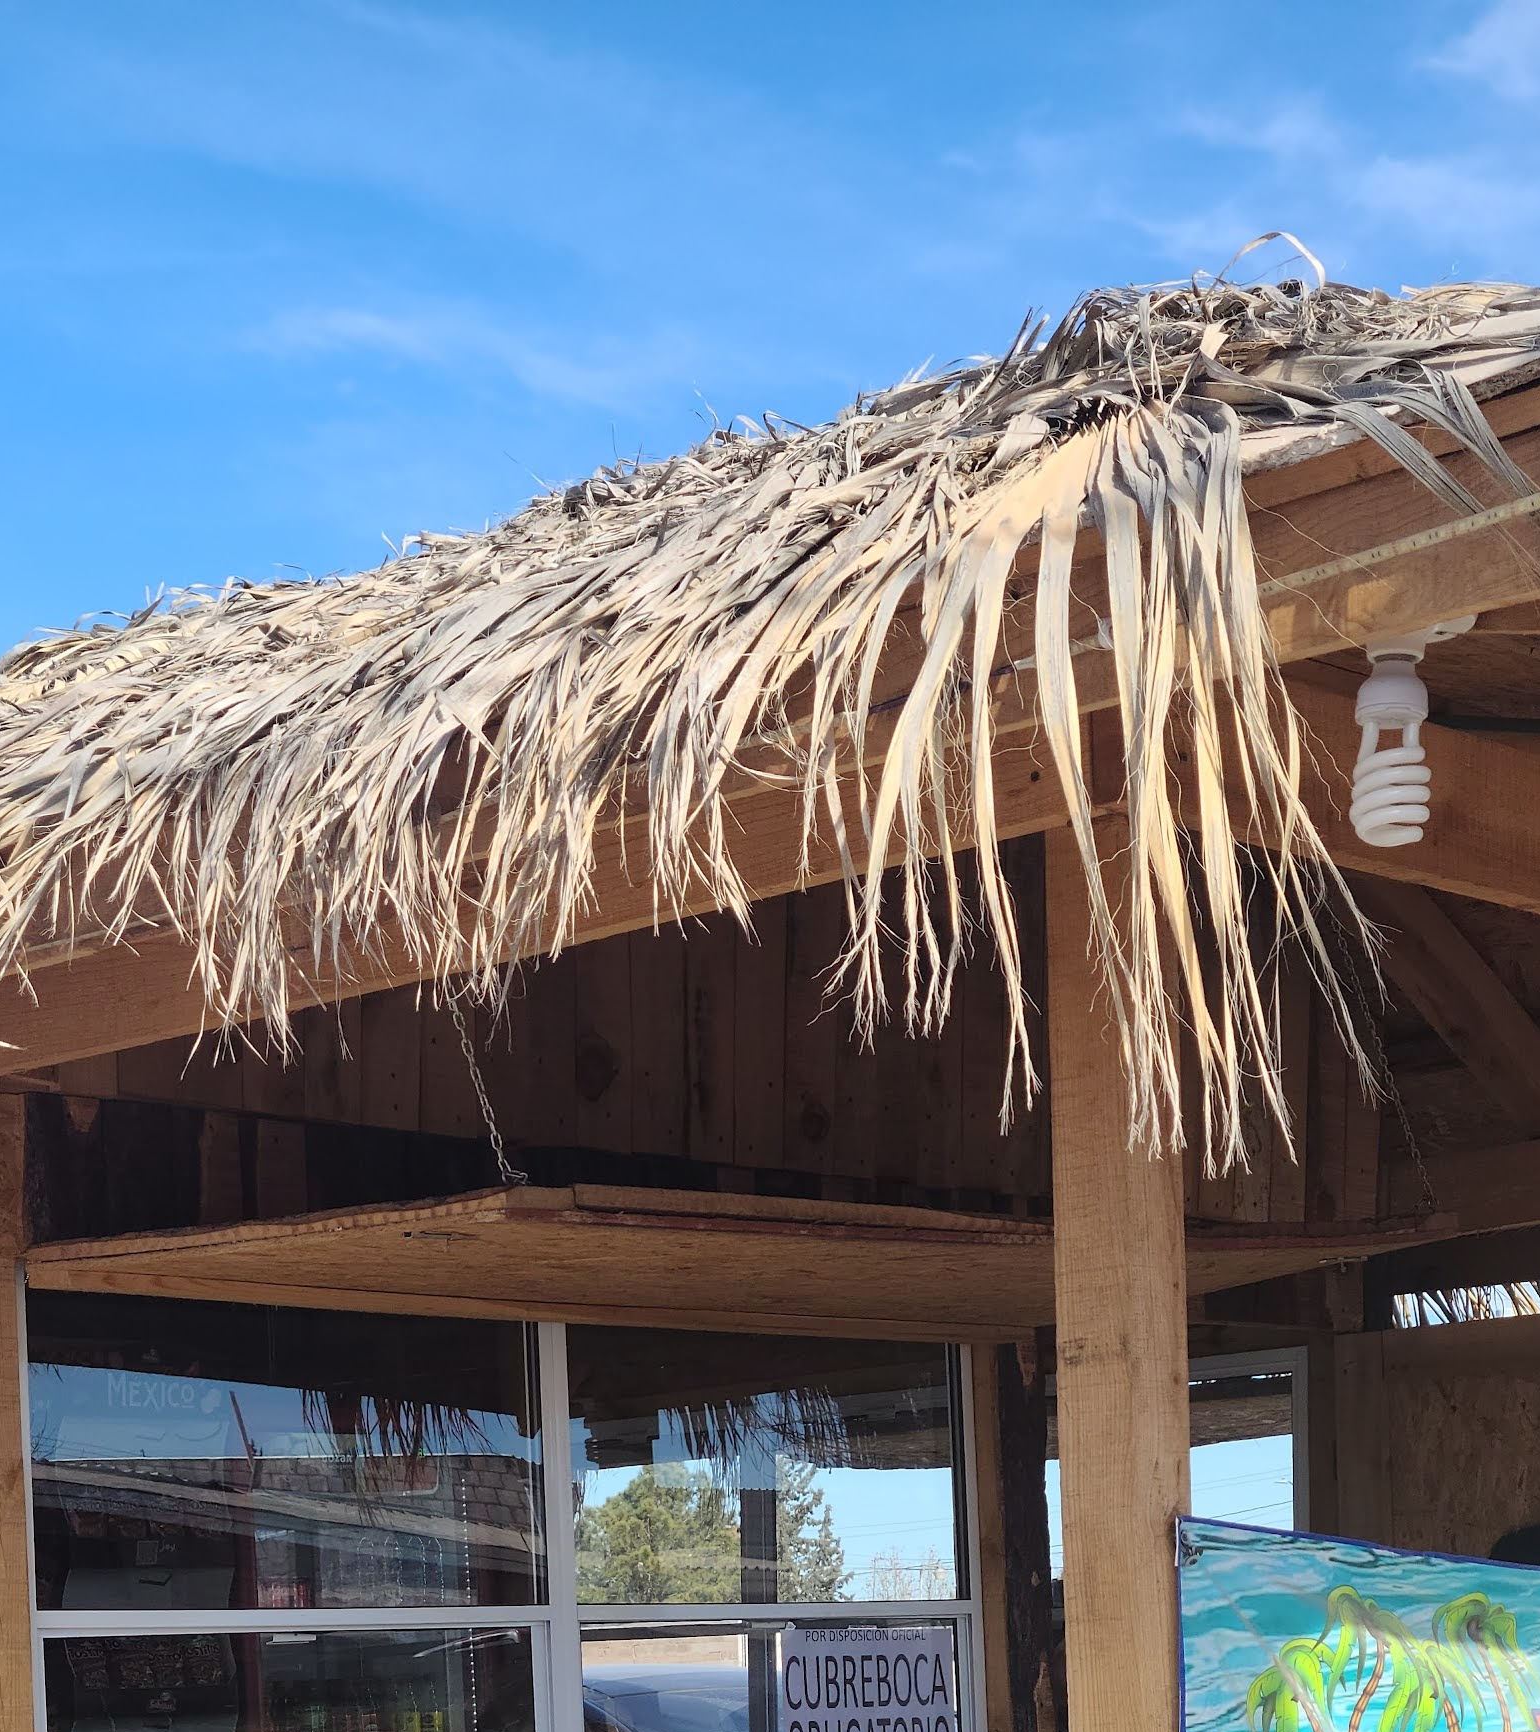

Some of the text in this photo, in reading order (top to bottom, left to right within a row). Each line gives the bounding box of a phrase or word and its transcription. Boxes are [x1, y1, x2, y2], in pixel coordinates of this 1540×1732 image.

[805, 1630, 826, 1642] POR
[891, 1629, 926, 1641] OFICIAL
[785, 1653, 949, 1710] CUBREBOCA
